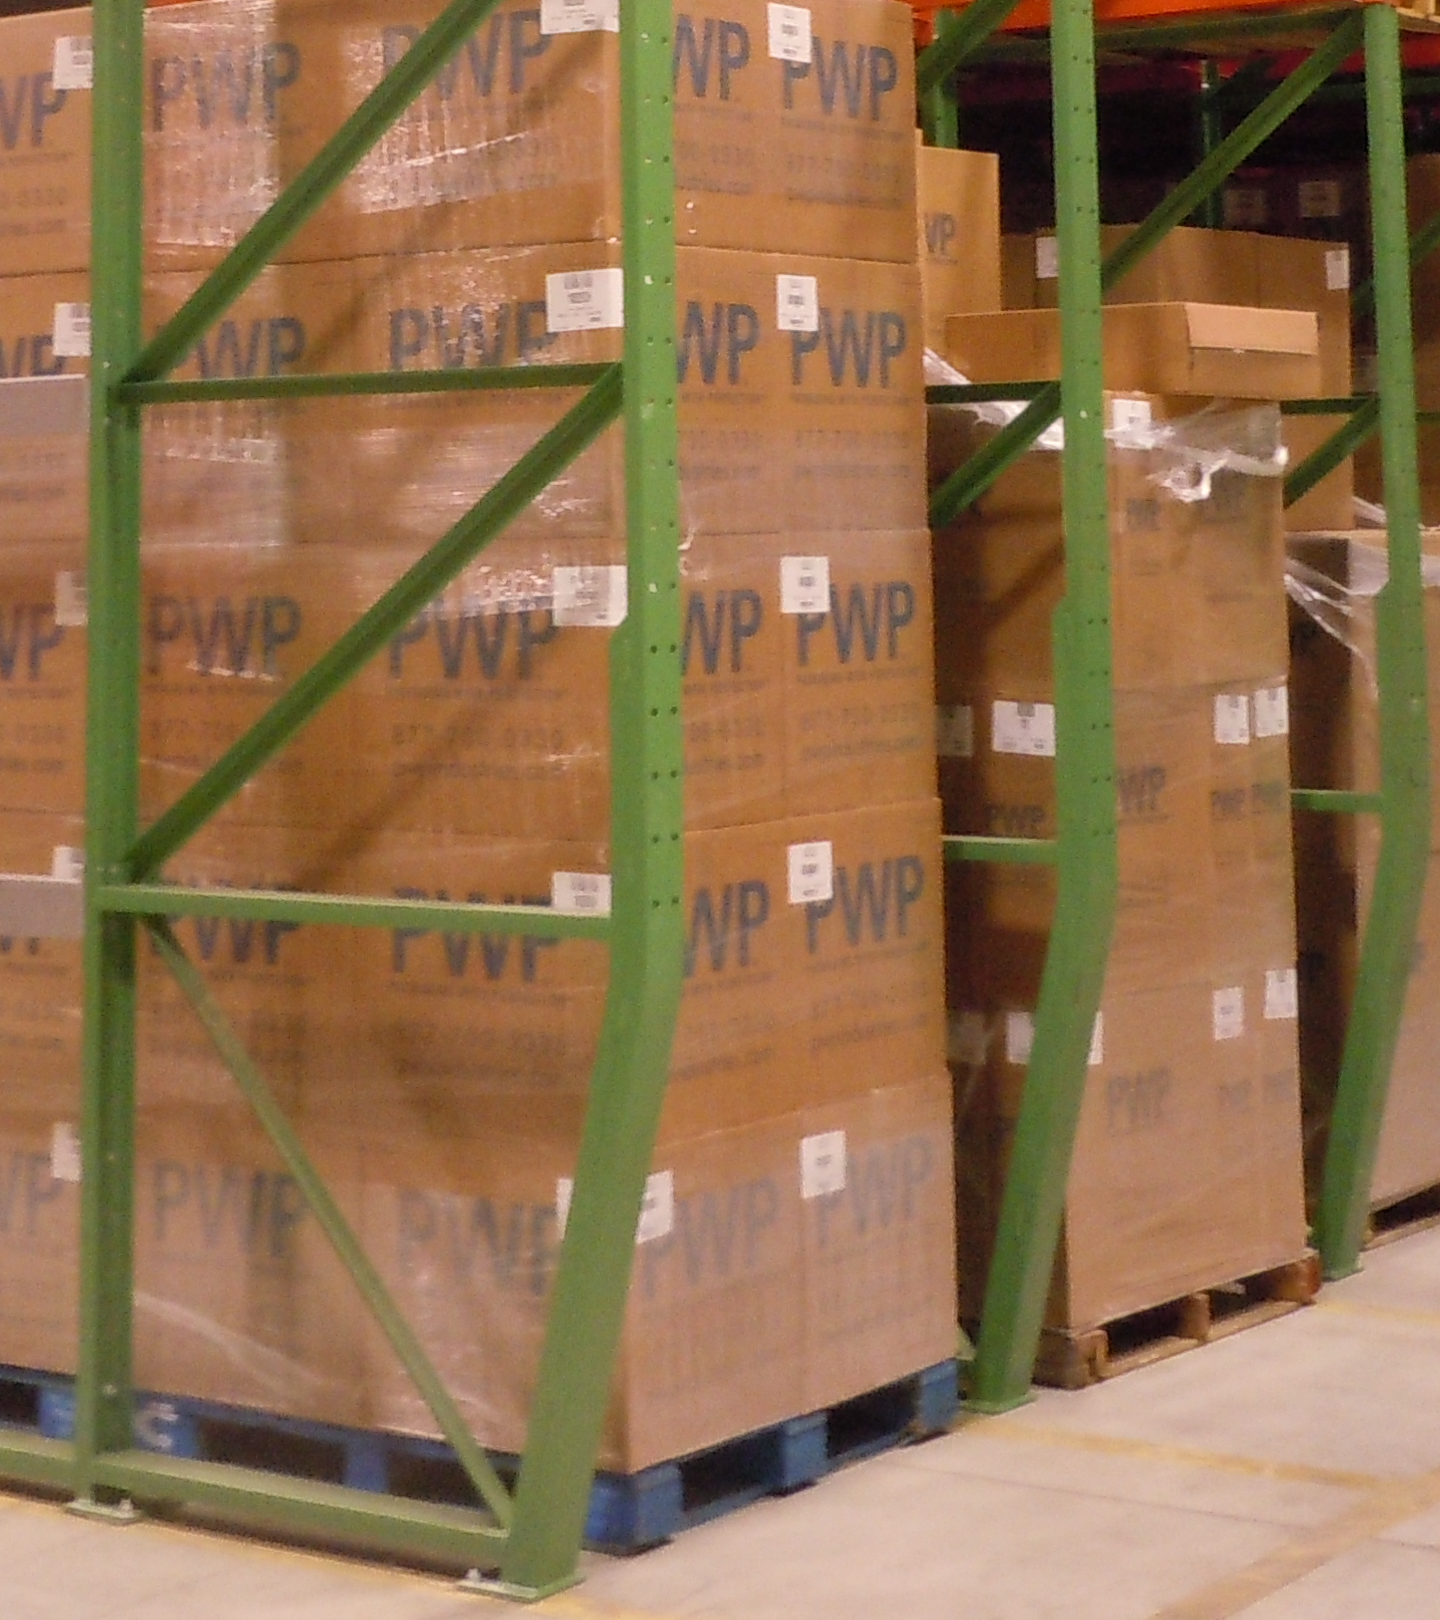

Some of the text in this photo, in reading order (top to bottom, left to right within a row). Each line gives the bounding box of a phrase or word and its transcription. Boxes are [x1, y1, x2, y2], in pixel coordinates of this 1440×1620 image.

[151, 41, 302, 133] PWP
[674, 12, 751, 100] WP
[782, 35, 898, 122] PWP
[926, 211, 957, 255] WP
[157, 314, 307, 380] WP
[388, 300, 559, 371] PWP
[674, 300, 760, 383] WP
[790, 308, 905, 388] PWP
[148, 594, 302, 679] PWP
[388, 594, 557, 680] PWP
[680, 589, 761, 675] WP
[796, 581, 915, 666] PWP
[1118, 769, 1168, 811] WP
[684, 881, 769, 977] WP
[804, 856, 924, 954] PWP
[151, 1158, 307, 1255] PWP
